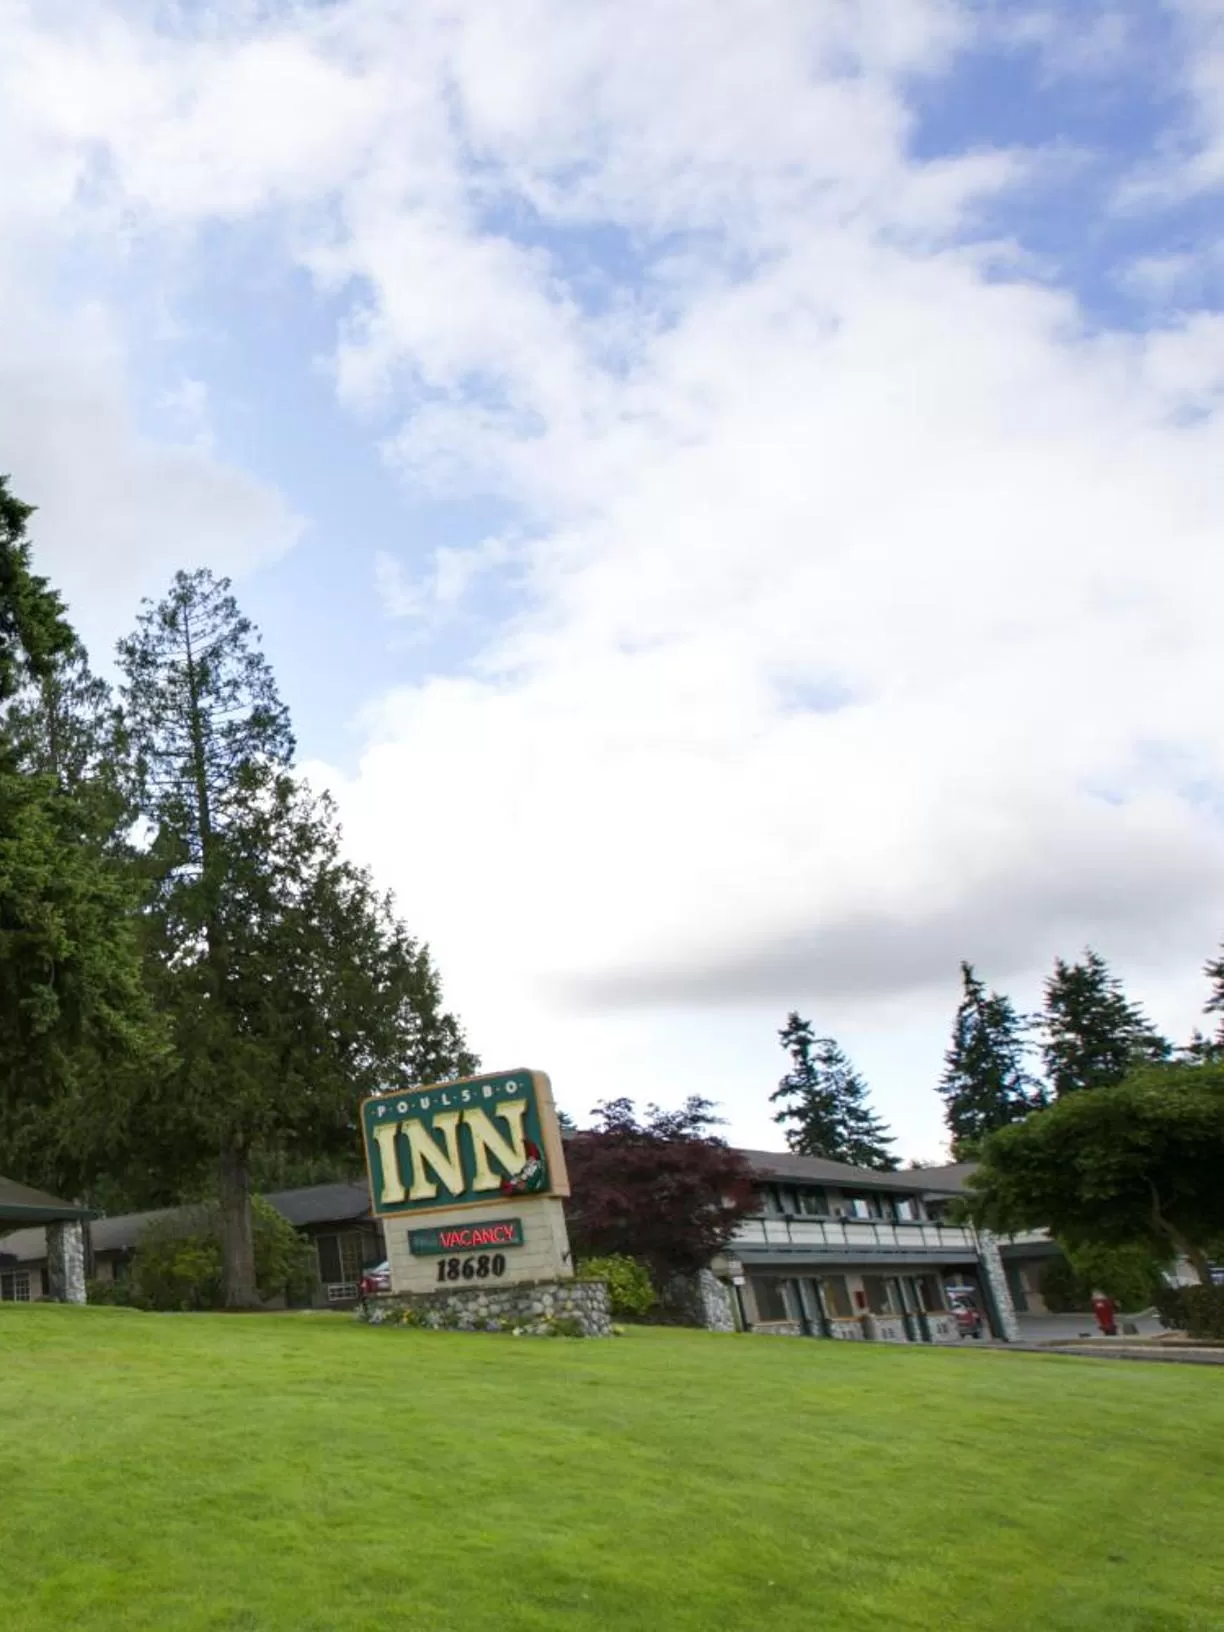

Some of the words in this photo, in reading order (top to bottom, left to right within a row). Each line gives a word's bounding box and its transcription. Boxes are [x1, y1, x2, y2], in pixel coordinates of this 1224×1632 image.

[373, 1100, 527, 1204] INN
[439, 1223, 515, 1248] VACANCY
[437, 1253, 506, 1282] 18680
